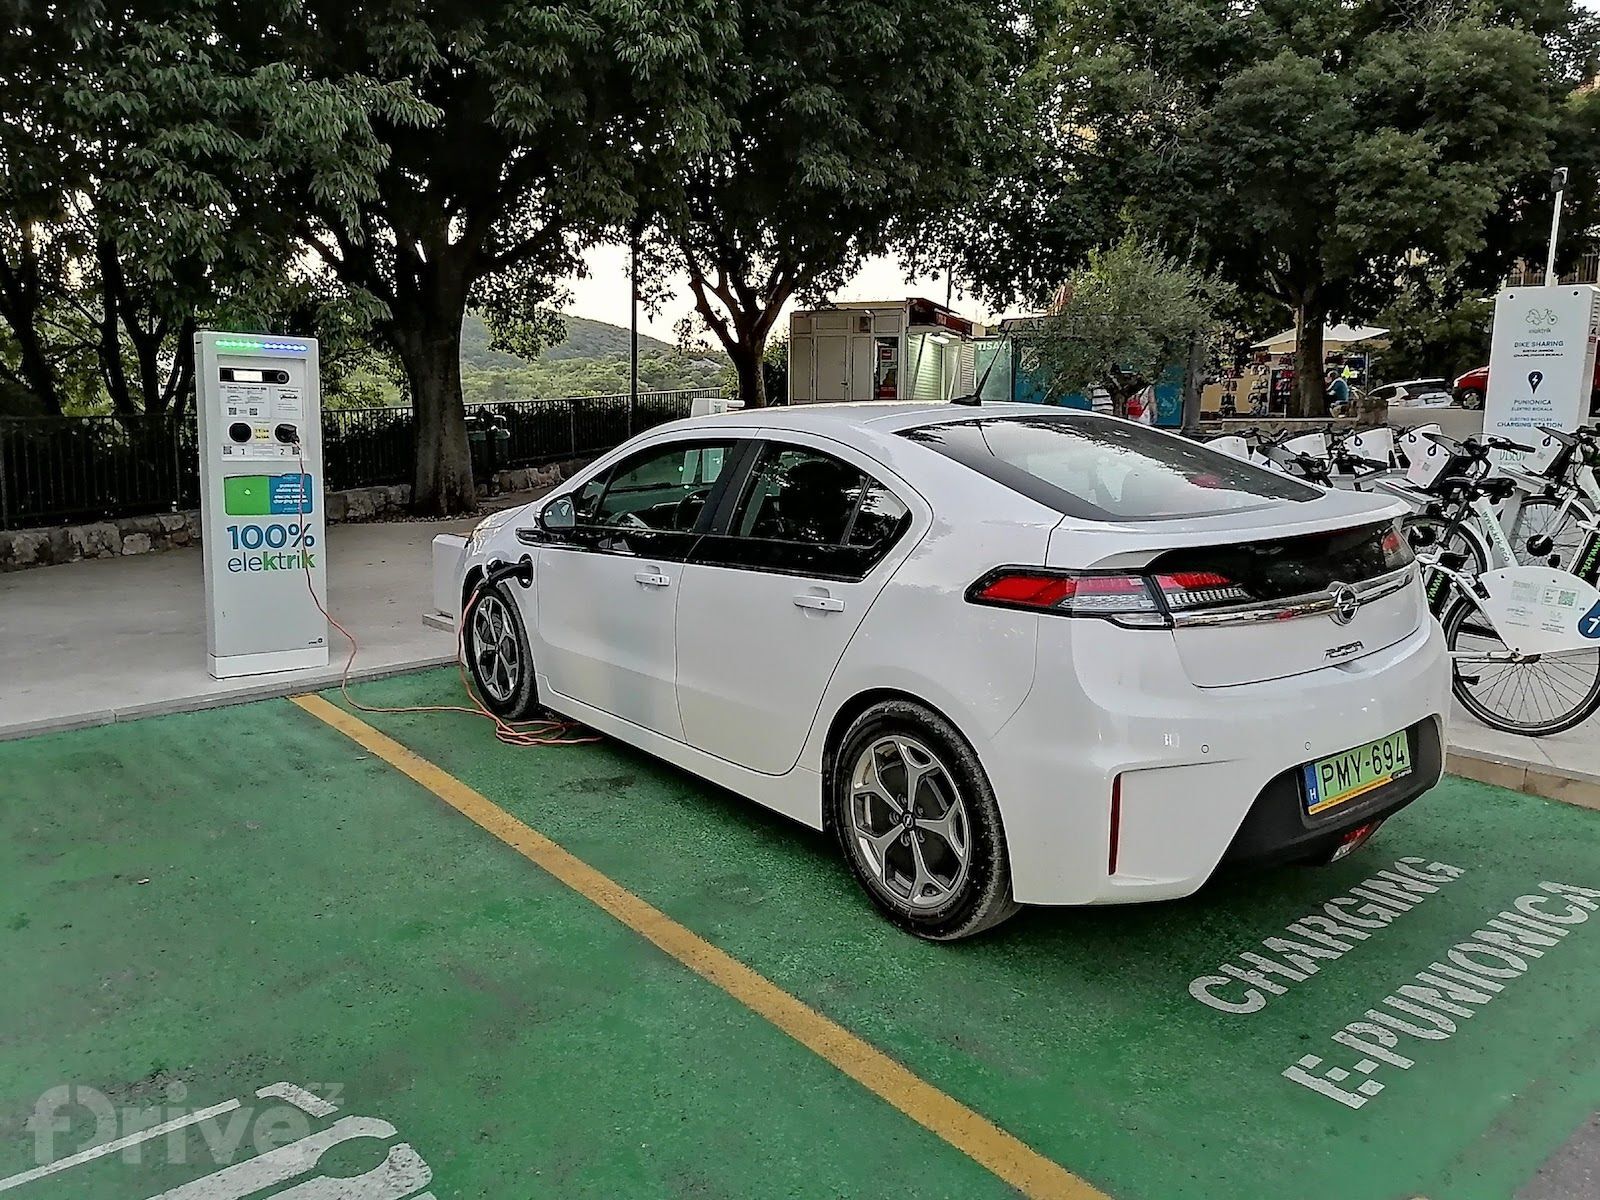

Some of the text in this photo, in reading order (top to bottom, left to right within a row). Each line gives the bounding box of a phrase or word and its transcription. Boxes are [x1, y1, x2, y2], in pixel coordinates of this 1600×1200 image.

[226, 523, 315, 550] 100%
[227, 549, 316, 573] elektrik
[1321, 736, 1405, 797] PMY-694
[1309, 787, 1317, 801] H
[1188, 856, 1466, 1014] CHARGING
[1281, 881, 1600, 1110] E-PUNIONICA
